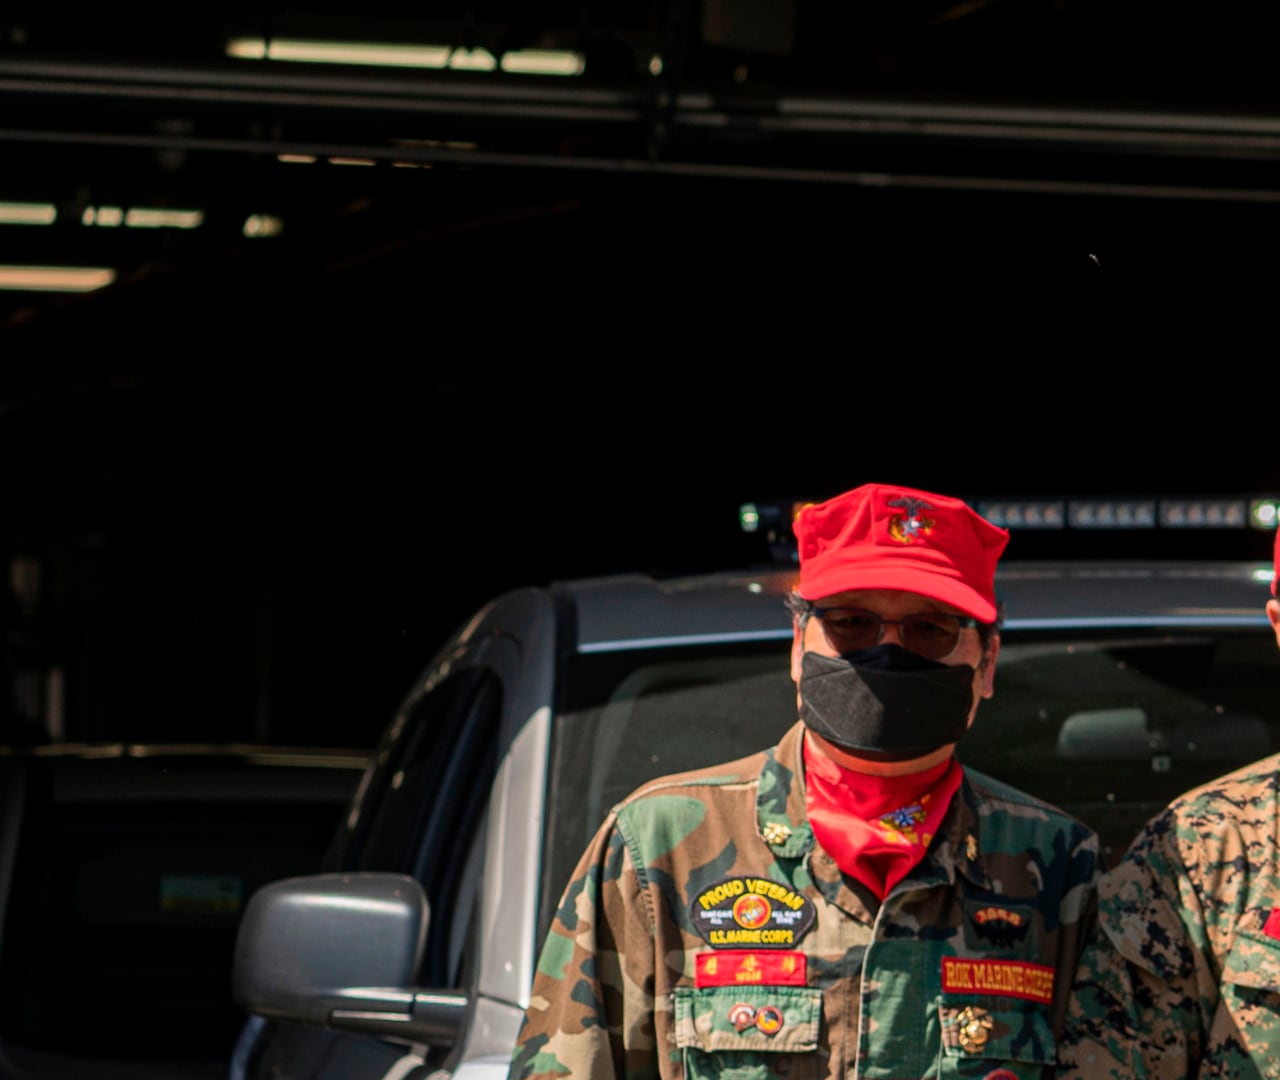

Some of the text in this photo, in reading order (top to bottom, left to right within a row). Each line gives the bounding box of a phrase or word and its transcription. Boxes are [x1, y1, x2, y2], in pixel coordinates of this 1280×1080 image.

[699, 878, 805, 911] PROUD VETERAN
[726, 929, 761, 945] MARINE
[761, 929, 794, 945] CORPS
[945, 961, 973, 989] ROK
[973, 963, 1024, 993] MARINE
